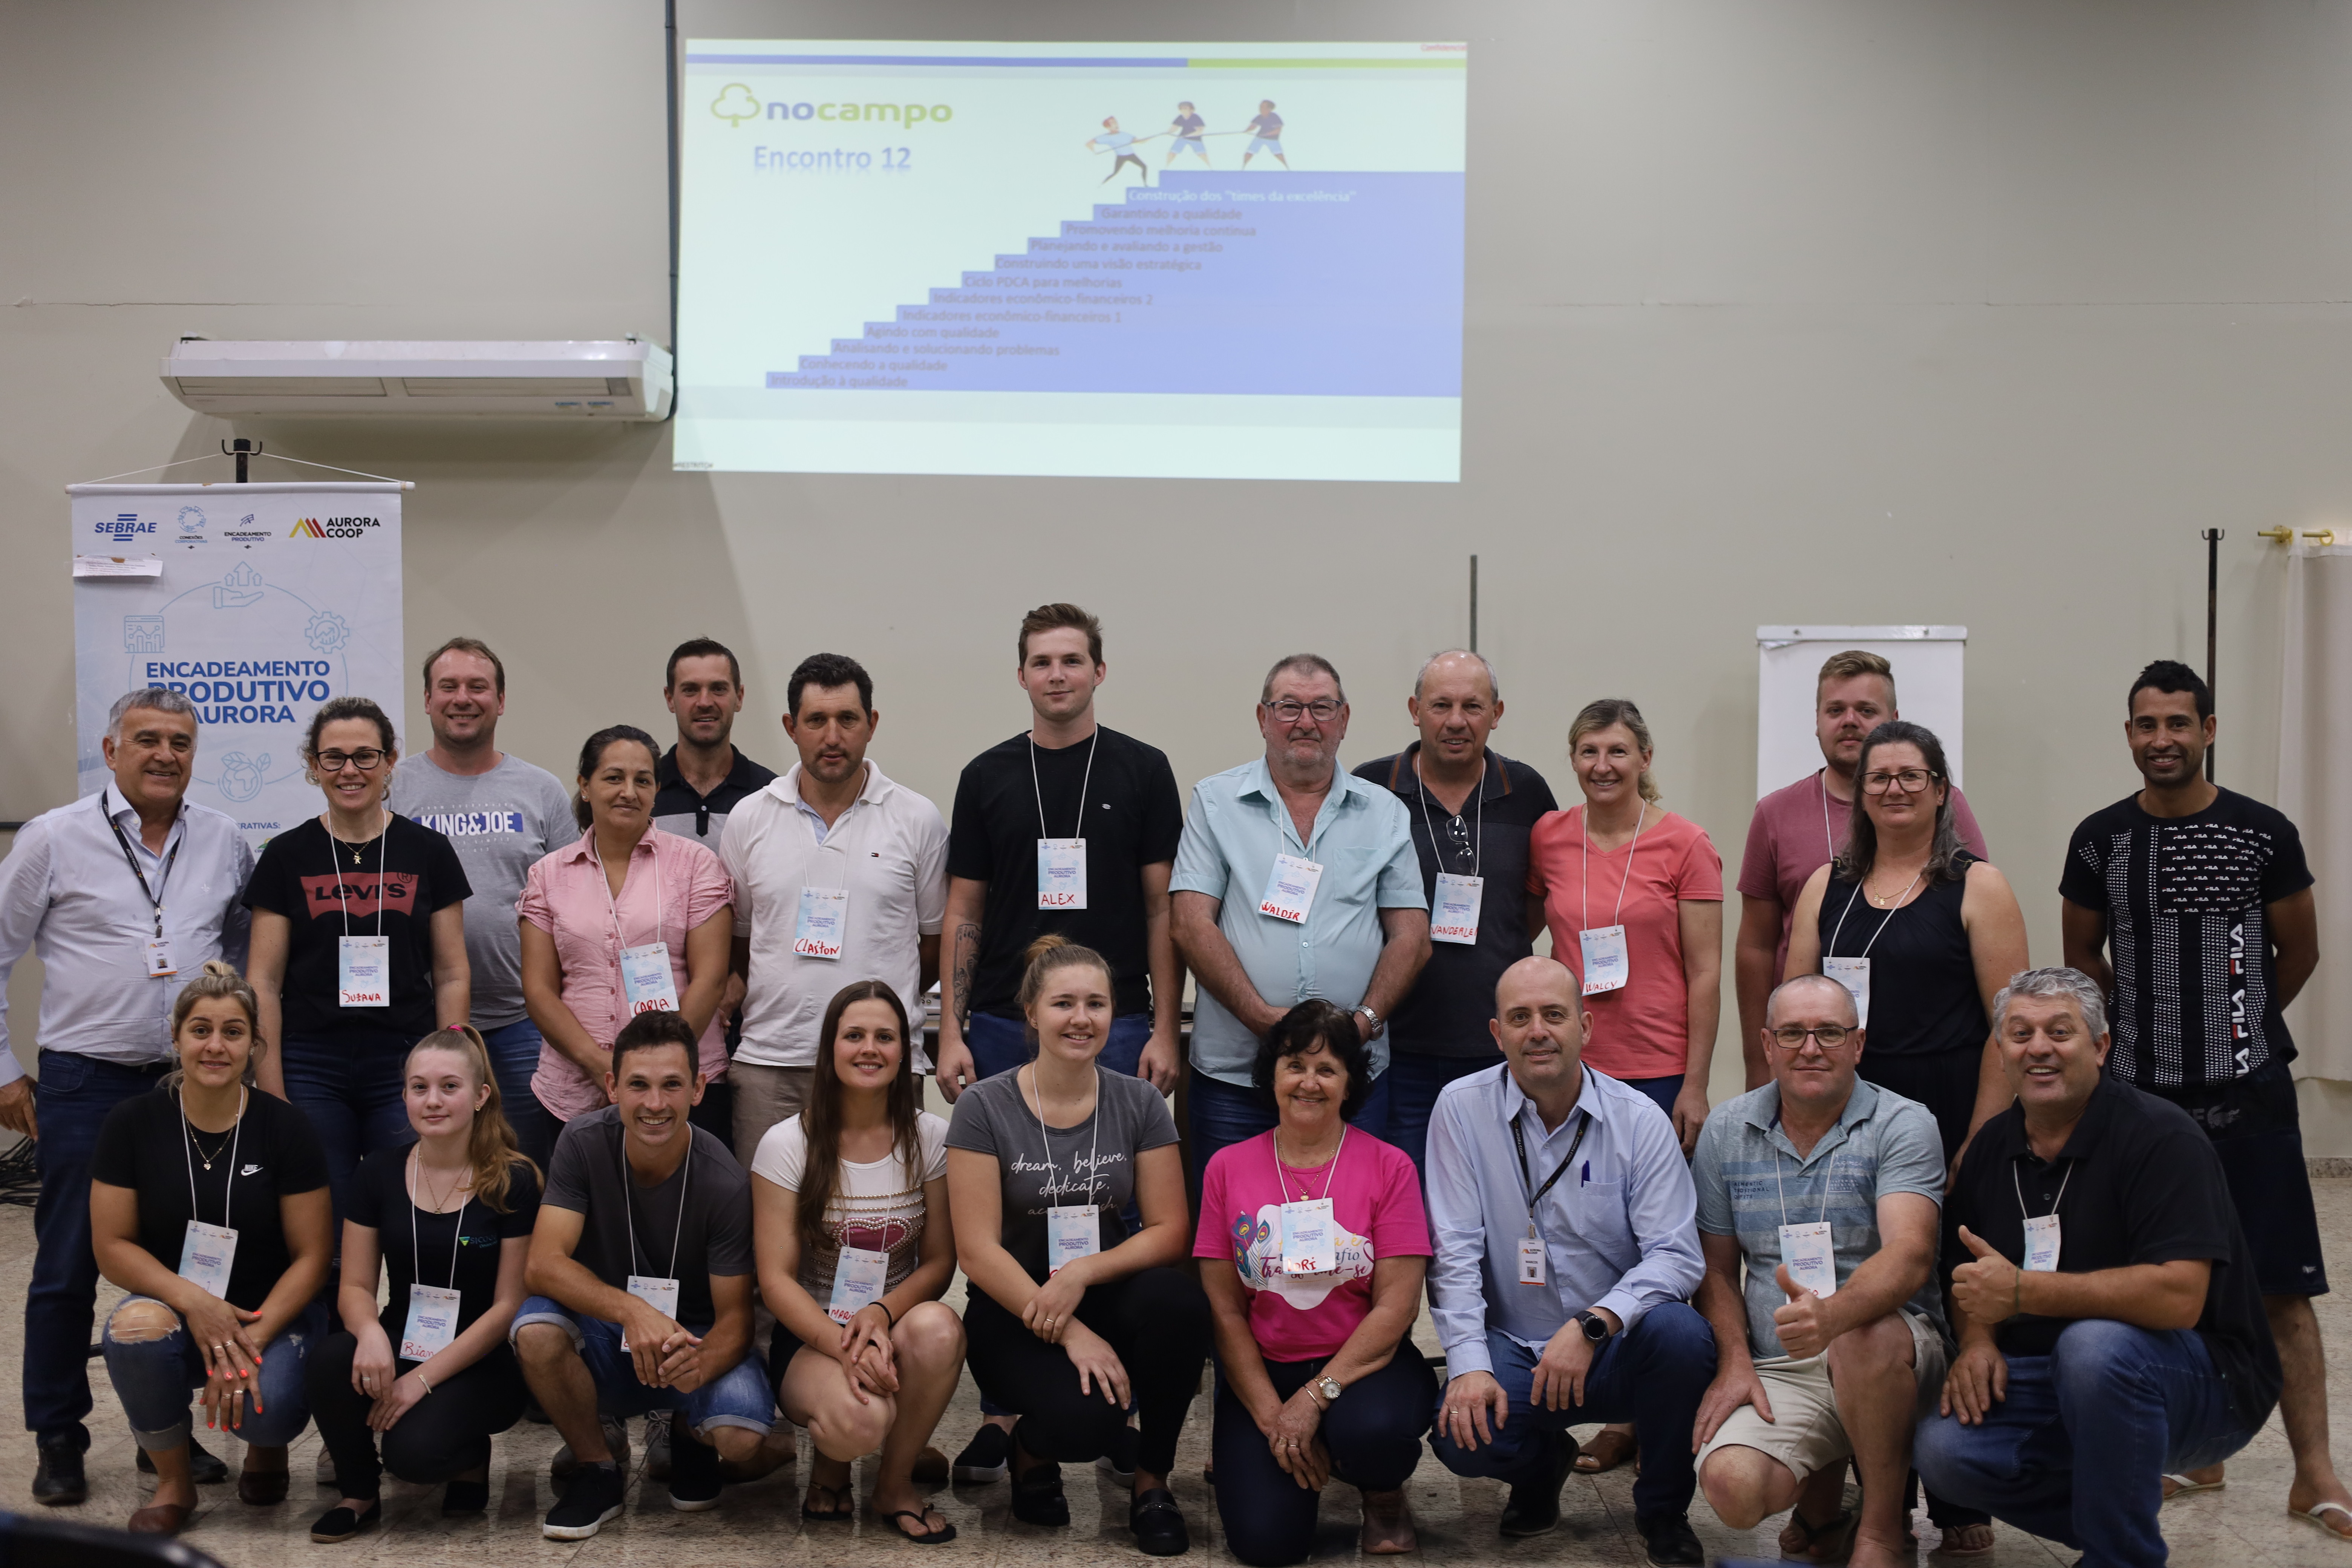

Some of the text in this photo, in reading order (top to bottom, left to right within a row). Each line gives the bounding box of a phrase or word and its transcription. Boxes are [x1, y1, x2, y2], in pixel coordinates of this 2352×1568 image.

[767, 102, 953, 129] nocampo
[754, 146, 912, 170] Encontro 12
[1129, 190, 1198, 203] Construção
[1200, 190, 1222, 201] dos
[1268, 190, 1284, 202] da
[1101, 208, 1243, 222] Garantindo a qualidade
[1066, 224, 1144, 236] Promovendo
[1146, 225, 1200, 236] melhoria
[1030, 240, 1223, 254] Planejando e avaliando a gestão
[995, 257, 1202, 272] Construindo uma visão estratégica
[964, 276, 1122, 290] Ciclo PDCA para melhorias
[933, 293, 1003, 305] Indicadores
[1145, 294, 1153, 306] 2
[903, 309, 1122, 323] Indicadores econômico-financeiros 1
[866, 326, 1000, 339] Agindo com qualidade
[833, 341, 1060, 357] Analisando e solucionando problemas
[799, 358, 948, 372] Conhecendo a qualidade
[771, 375, 836, 389] Introdução
[850, 375, 908, 389] qualidade
[95, 522, 157, 533] SEBRAE
[326, 517, 381, 528] AURORA
[326, 528, 364, 539] COOP
[147, 660, 330, 678] ENCADEAMENTO
[421, 811, 515, 837] KING&JOE
[1277, 884, 1305, 894] PRODUTIVO
[1041, 893, 1075, 905] ALEX
[1262, 902, 1301, 921] WALDIR
[2230, 923, 2244, 975] FILA
[634, 975, 663, 984] PRODUTIVO
[634, 998, 670, 1015] CARLA
[2232, 989, 2249, 1039] FILA
[192, 1256, 221, 1266] PRODUTIVO
[417, 1318, 446, 1327] PRODUTIVO
